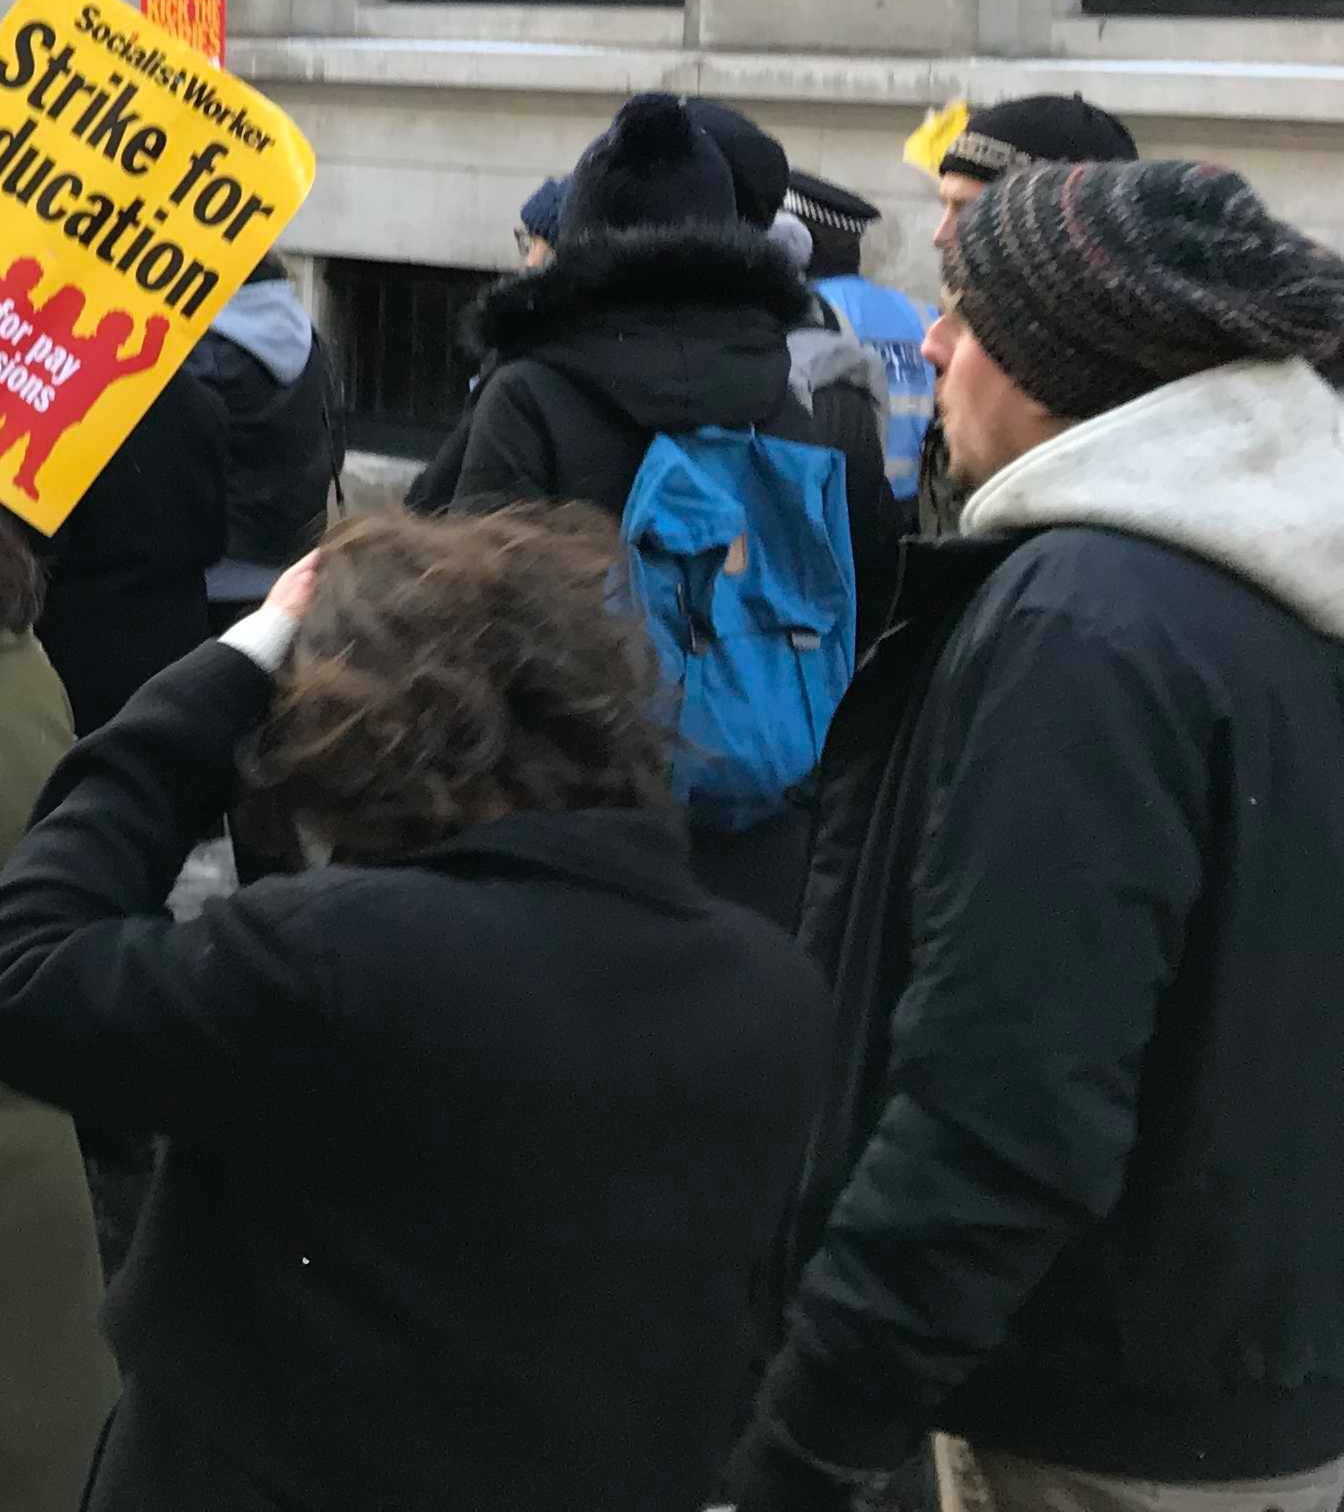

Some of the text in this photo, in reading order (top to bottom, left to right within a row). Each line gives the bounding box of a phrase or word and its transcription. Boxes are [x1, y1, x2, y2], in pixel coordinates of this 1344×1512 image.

[74, 3, 274, 153] Socialist Worker
[168, 141, 275, 243] for
[24, 333, 82, 387] pay
